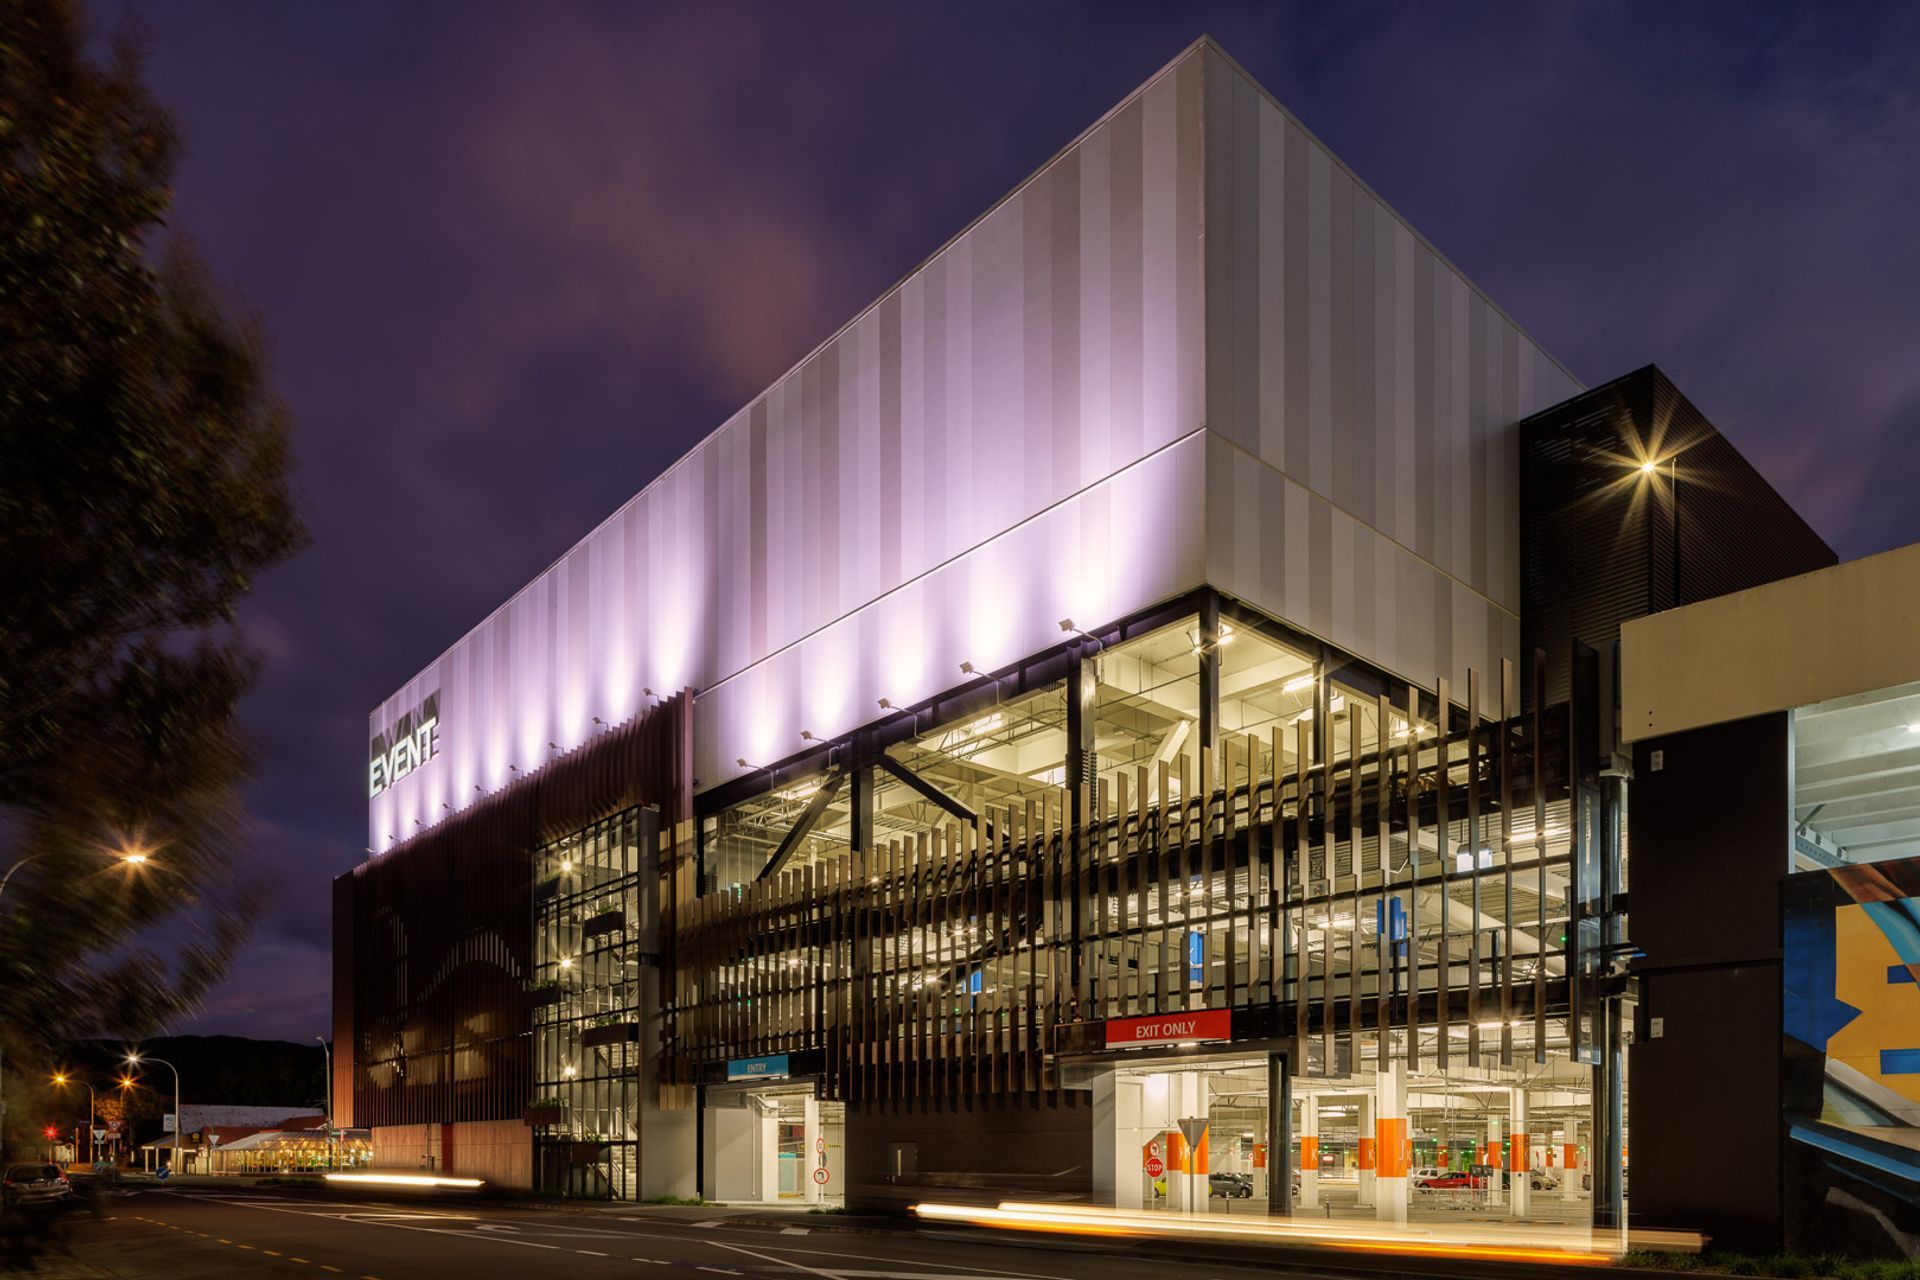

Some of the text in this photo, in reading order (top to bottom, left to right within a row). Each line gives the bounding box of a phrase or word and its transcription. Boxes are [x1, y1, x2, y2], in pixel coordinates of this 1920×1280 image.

[369, 716, 437, 798] EVENT
[1136, 1020, 1196, 1038] EXIT ONLY
[747, 1062, 767, 1073] ENTRY
[1311, 1148, 1318, 1161] K
[1368, 1149, 1374, 1161] K
[1399, 1137, 1405, 1161] J
[1147, 1163, 1163, 1172] STOP
